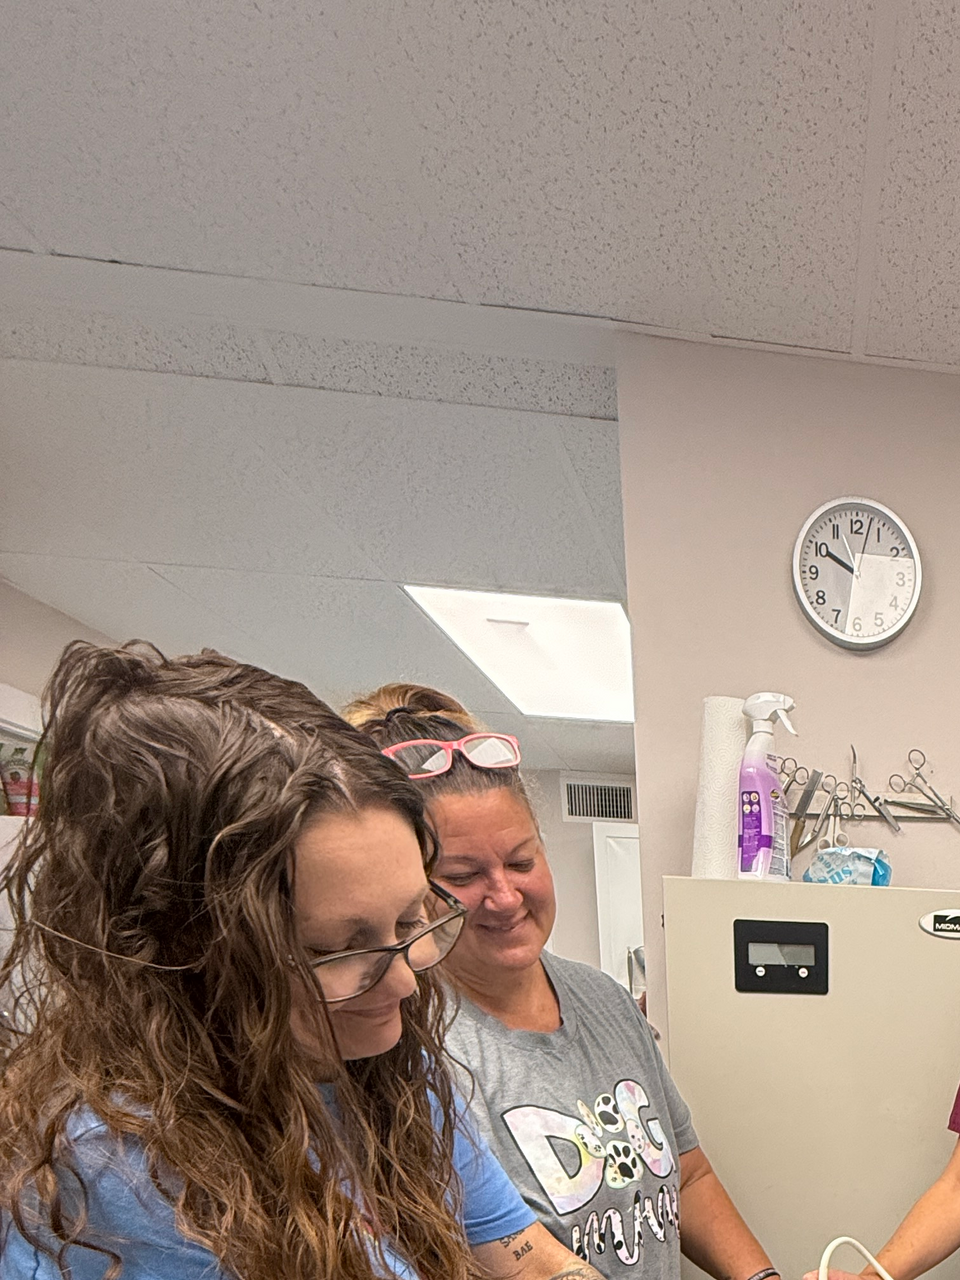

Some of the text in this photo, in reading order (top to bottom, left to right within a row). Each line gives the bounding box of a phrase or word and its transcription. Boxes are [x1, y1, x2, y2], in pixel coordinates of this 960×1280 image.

[832, 523, 840, 540] 11
[850, 518, 864, 535] 12
[814, 541, 829, 558] 10
[889, 546, 900, 562] 2
[808, 565, 819, 581] 9
[895, 571, 906, 587] 3
[815, 590, 826, 606] 8
[889, 595, 900, 611] 4
[831, 608, 842, 624] 7
[852, 616, 863, 632] 6
[874, 612, 885, 627] 5
[512, 1240, 534, 1261] BAE
